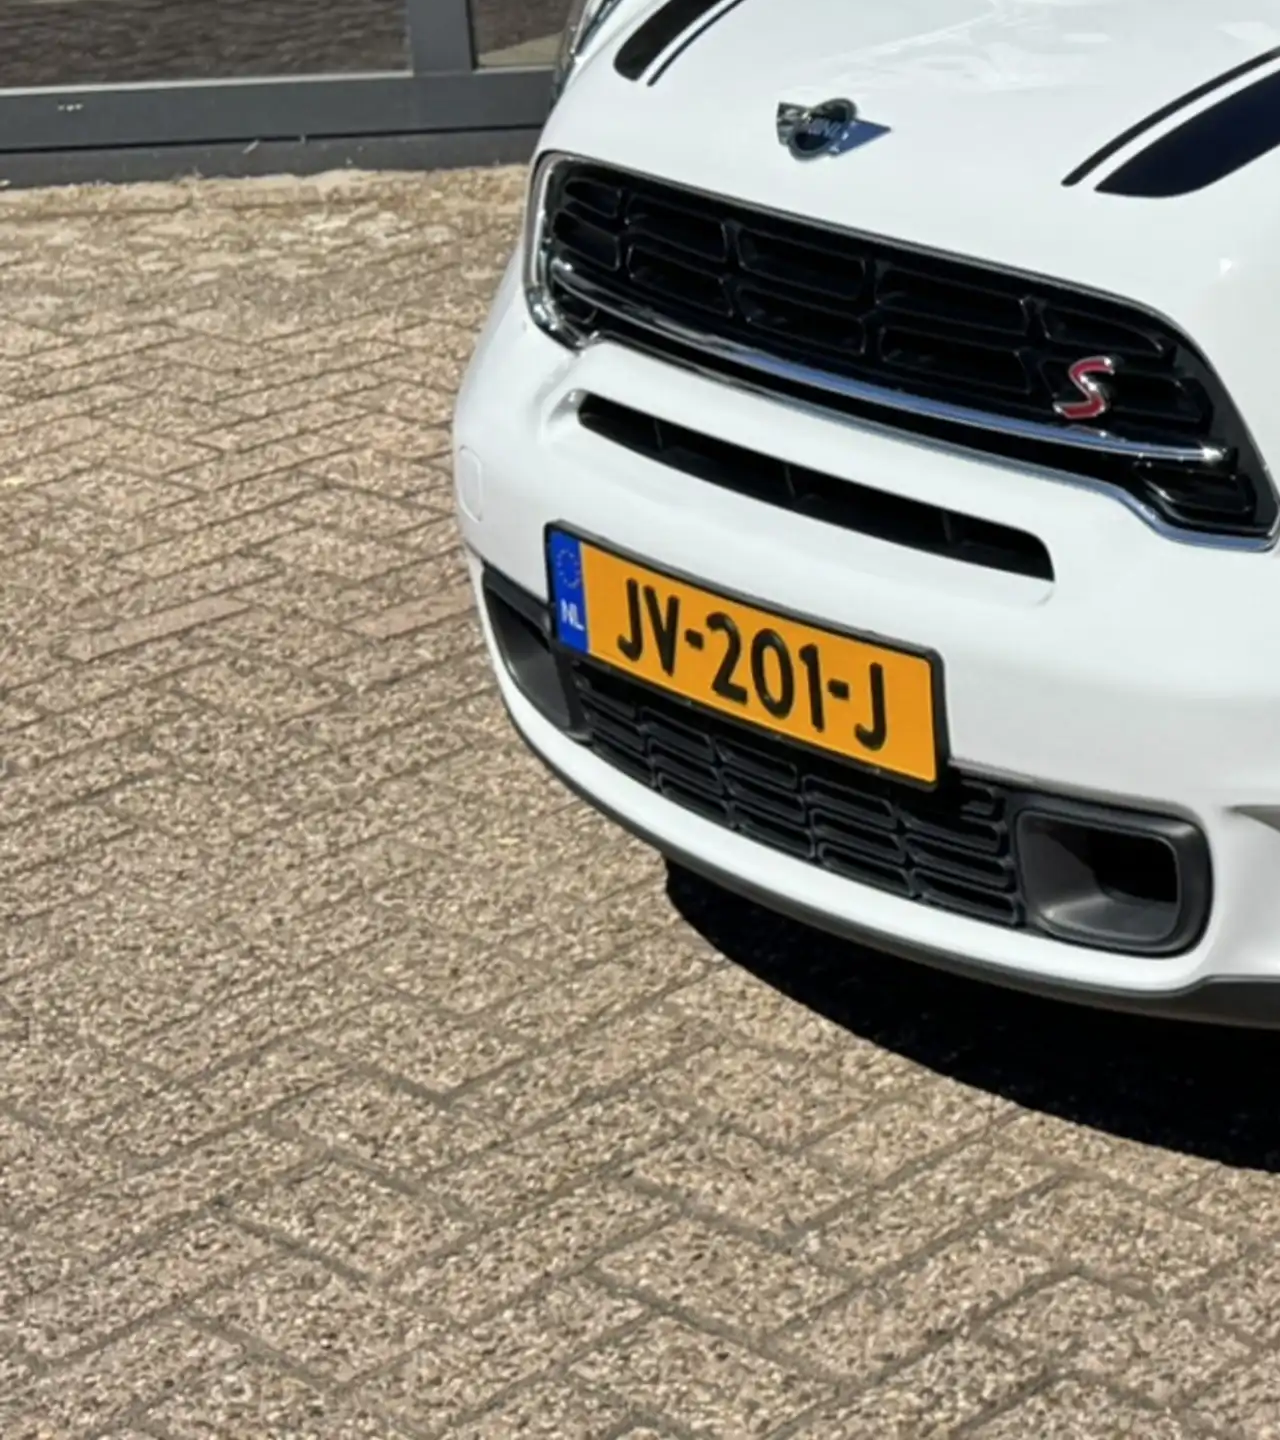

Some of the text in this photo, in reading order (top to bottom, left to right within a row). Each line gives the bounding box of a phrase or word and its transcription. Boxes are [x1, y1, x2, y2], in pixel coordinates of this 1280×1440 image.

[1053, 356, 1114, 419] S
[560, 599, 584, 631] NL
[617, 578, 888, 752] JV-201-J
